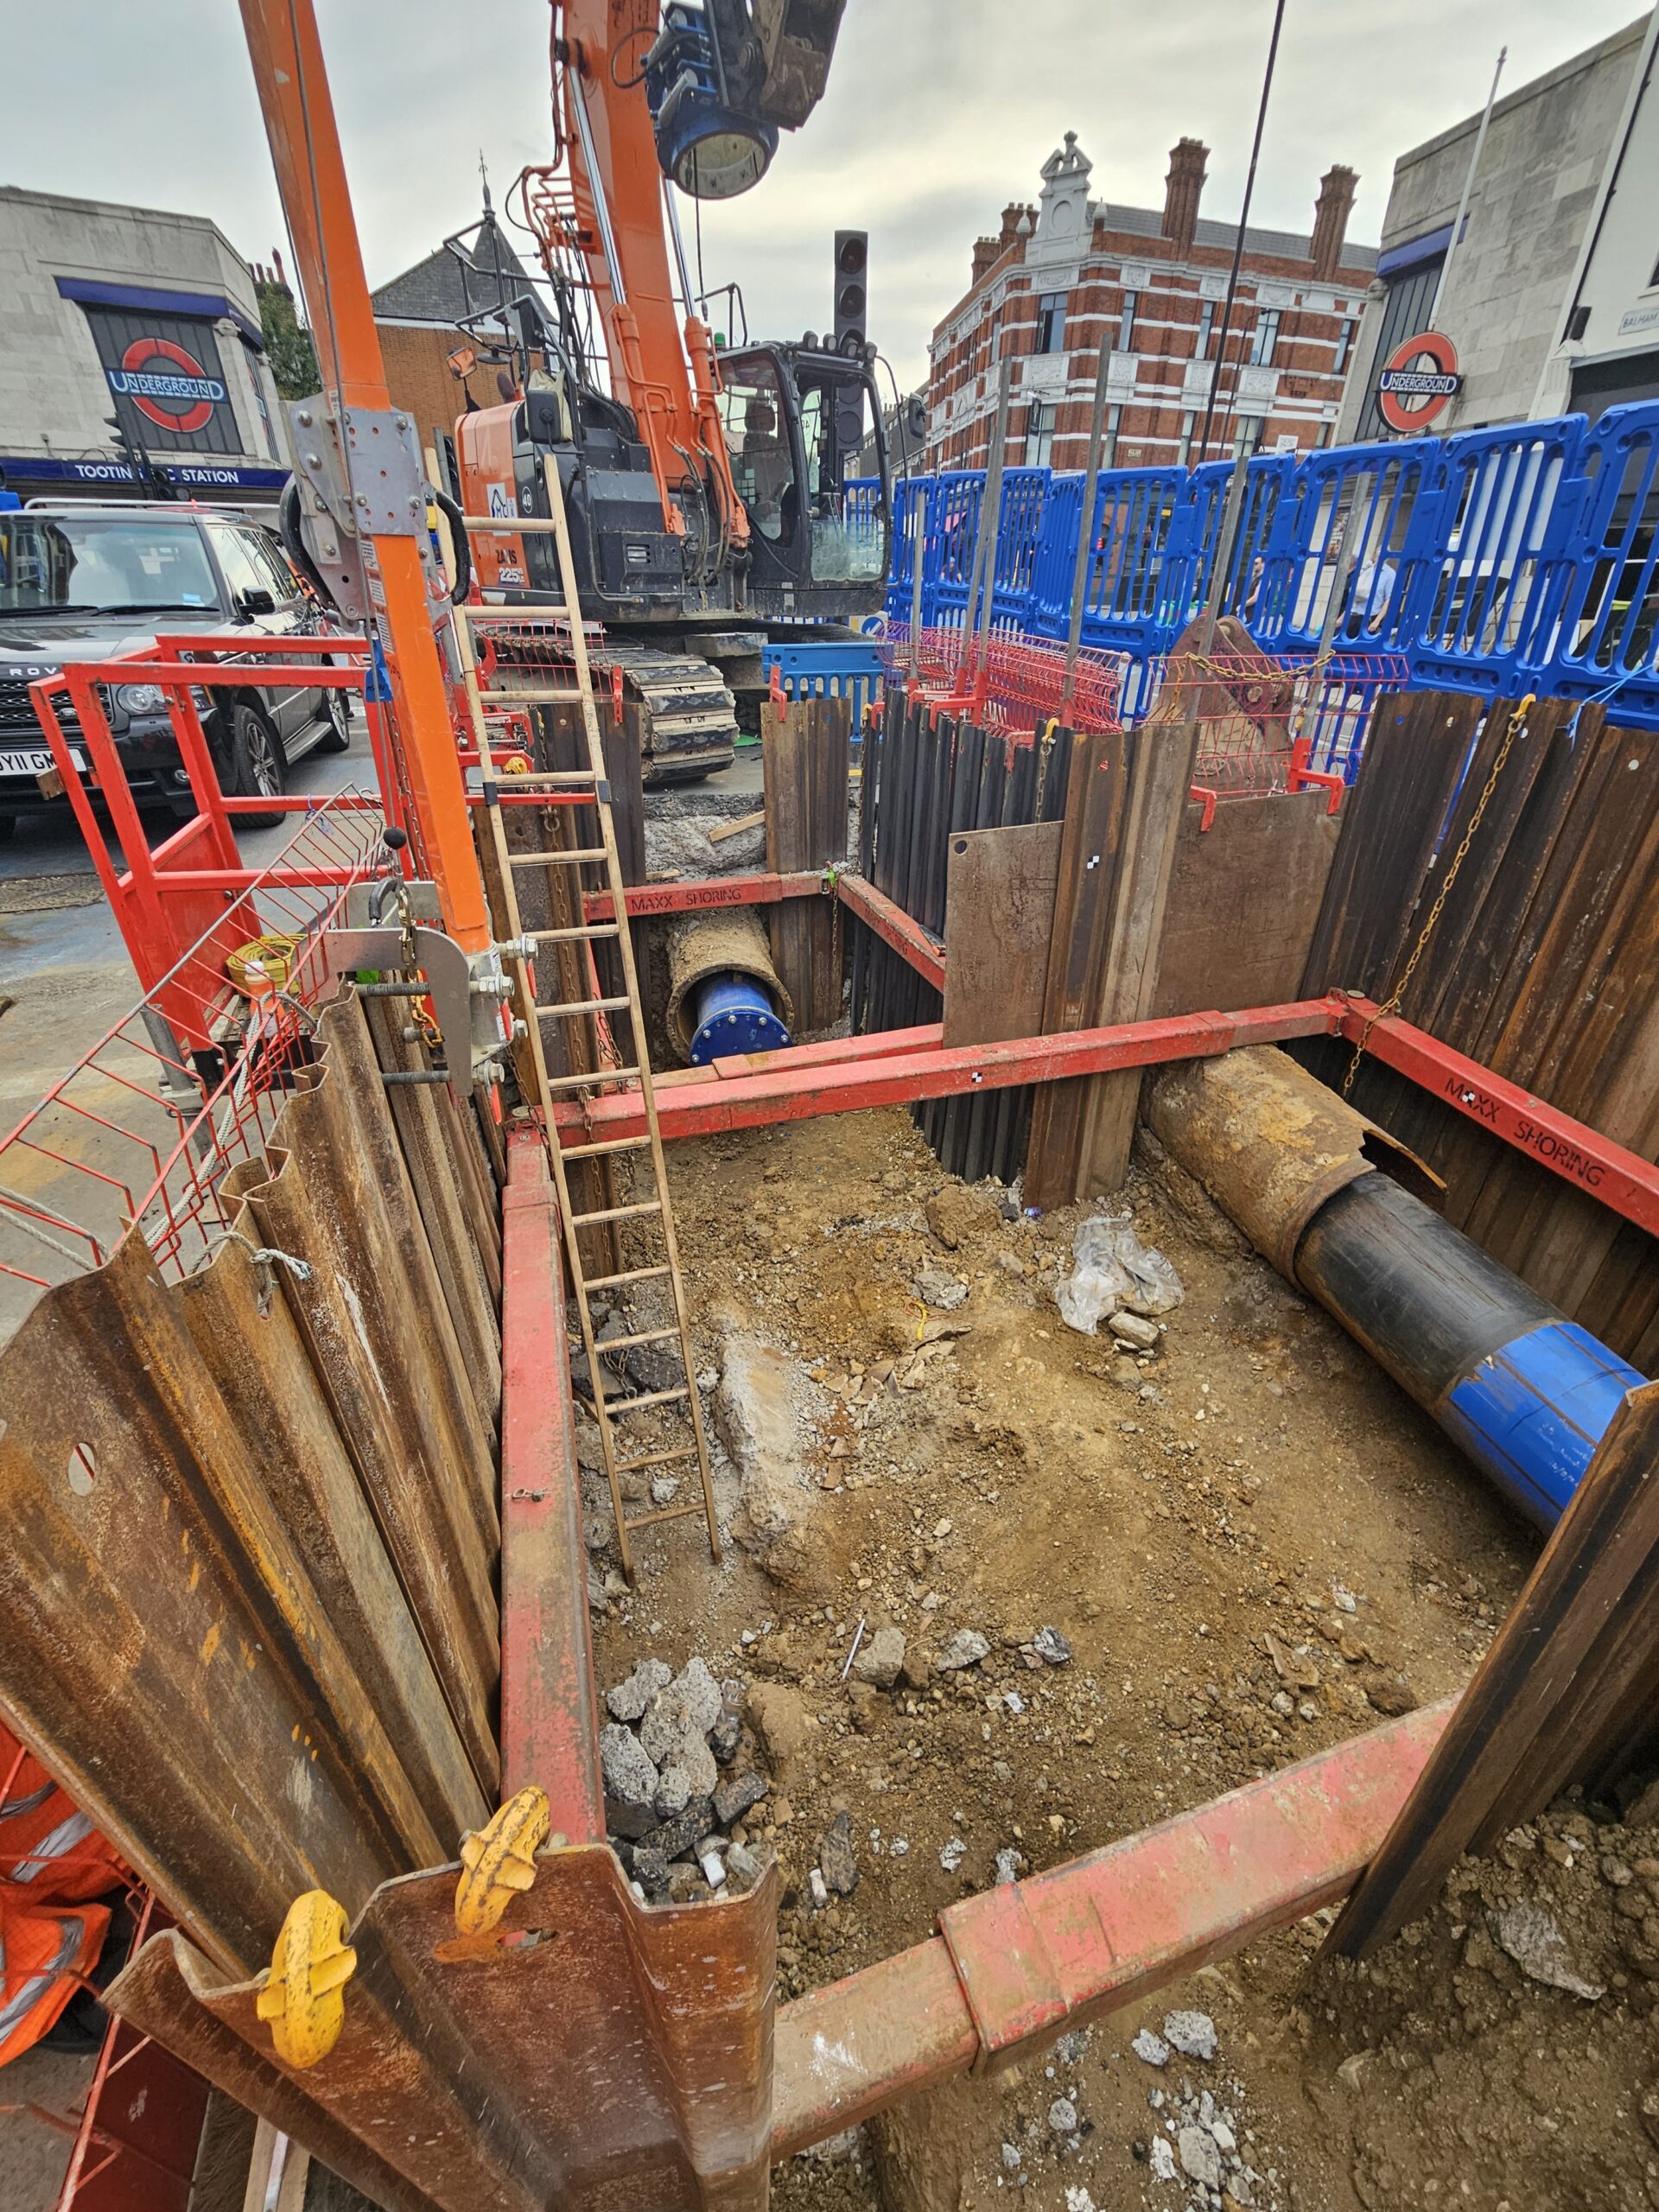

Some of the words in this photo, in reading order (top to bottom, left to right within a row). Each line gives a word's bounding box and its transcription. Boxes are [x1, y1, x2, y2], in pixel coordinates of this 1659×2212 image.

[109, 371, 224, 400] UNDERGROUND
[1380, 372, 1458, 393] UNDERGROUND
[74, 464, 143, 480] TOOTIN
[181, 469, 239, 484] STATION
[522, 494, 531, 506] 40
[499, 567, 519, 583] 225
[10, 667, 57, 676] ROV
[30, 753, 57, 769] GM
[632, 895, 672, 912] MAXX
[686, 888, 741, 906] SHORING
[1514, 1121, 1605, 1186] SHORING
